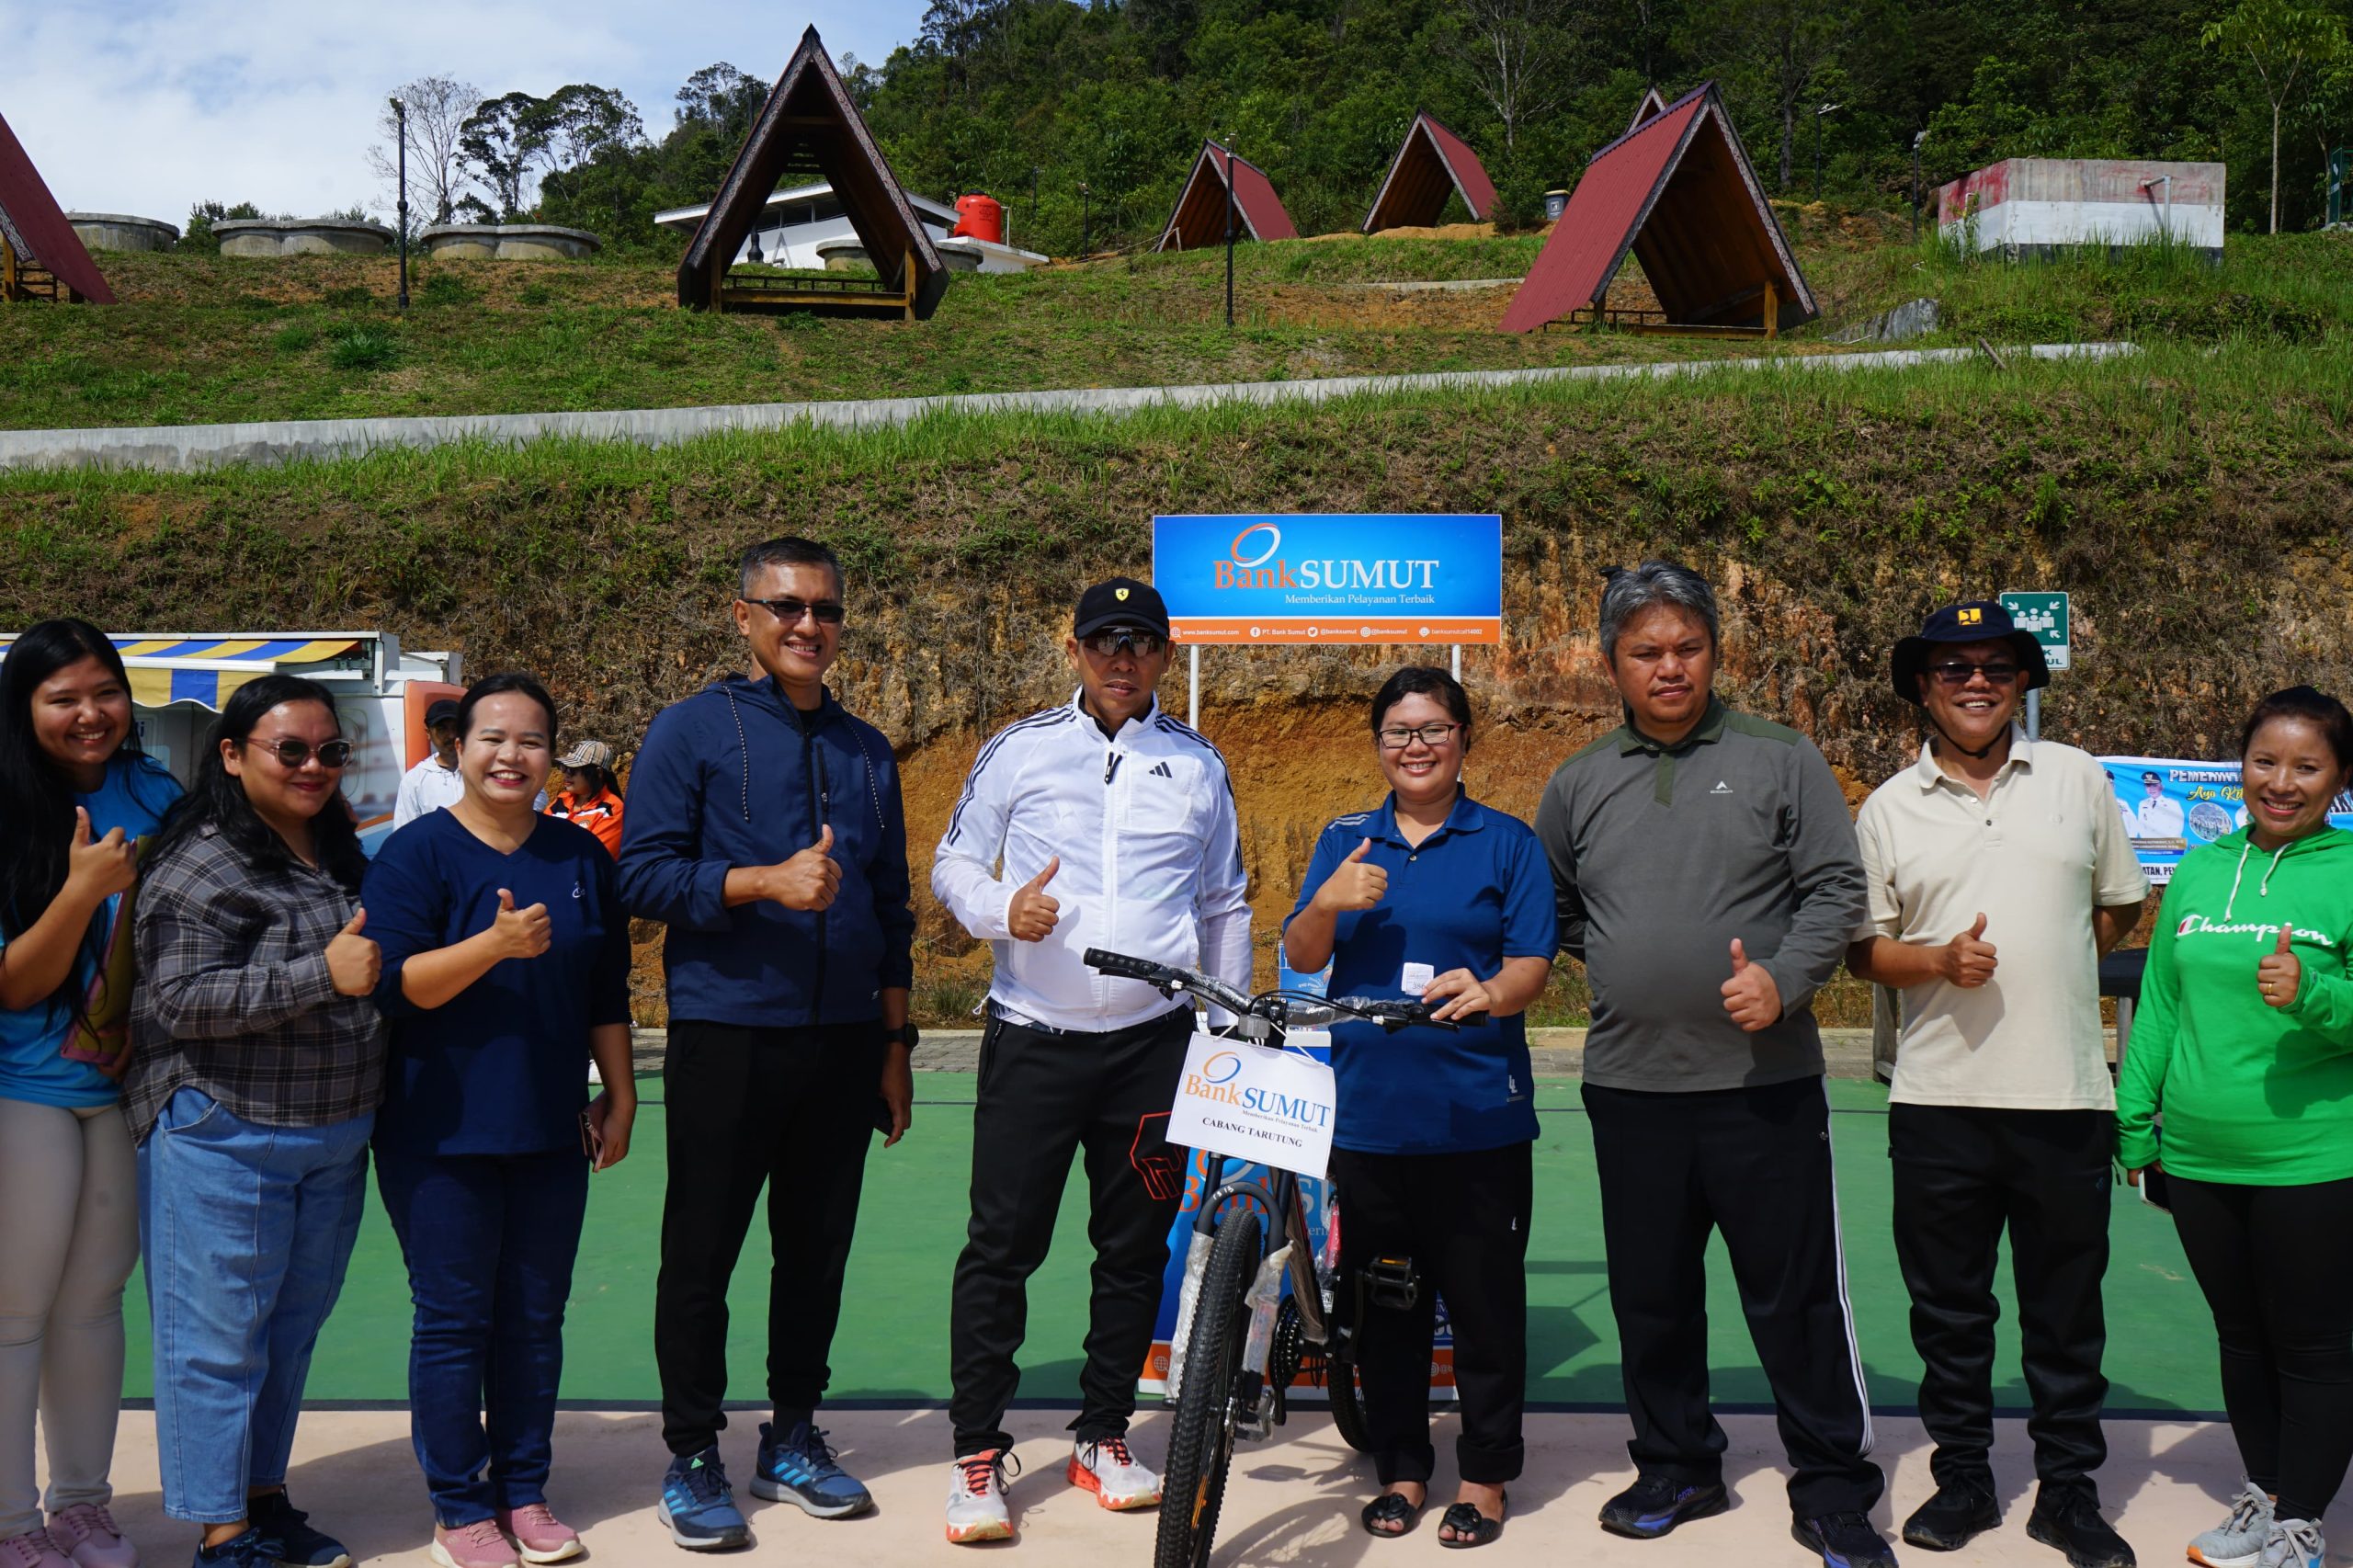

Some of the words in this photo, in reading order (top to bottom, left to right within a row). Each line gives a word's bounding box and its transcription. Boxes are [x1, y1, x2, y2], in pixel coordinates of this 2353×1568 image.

[1285, 594, 1346, 605] Memberikan
[1347, 594, 1397, 607] Pelayanan
[1398, 594, 1435, 605] Terbaik
[1202, 1117, 1245, 1135] CABANG
[1247, 1126, 1302, 1148] TARUTUNG
